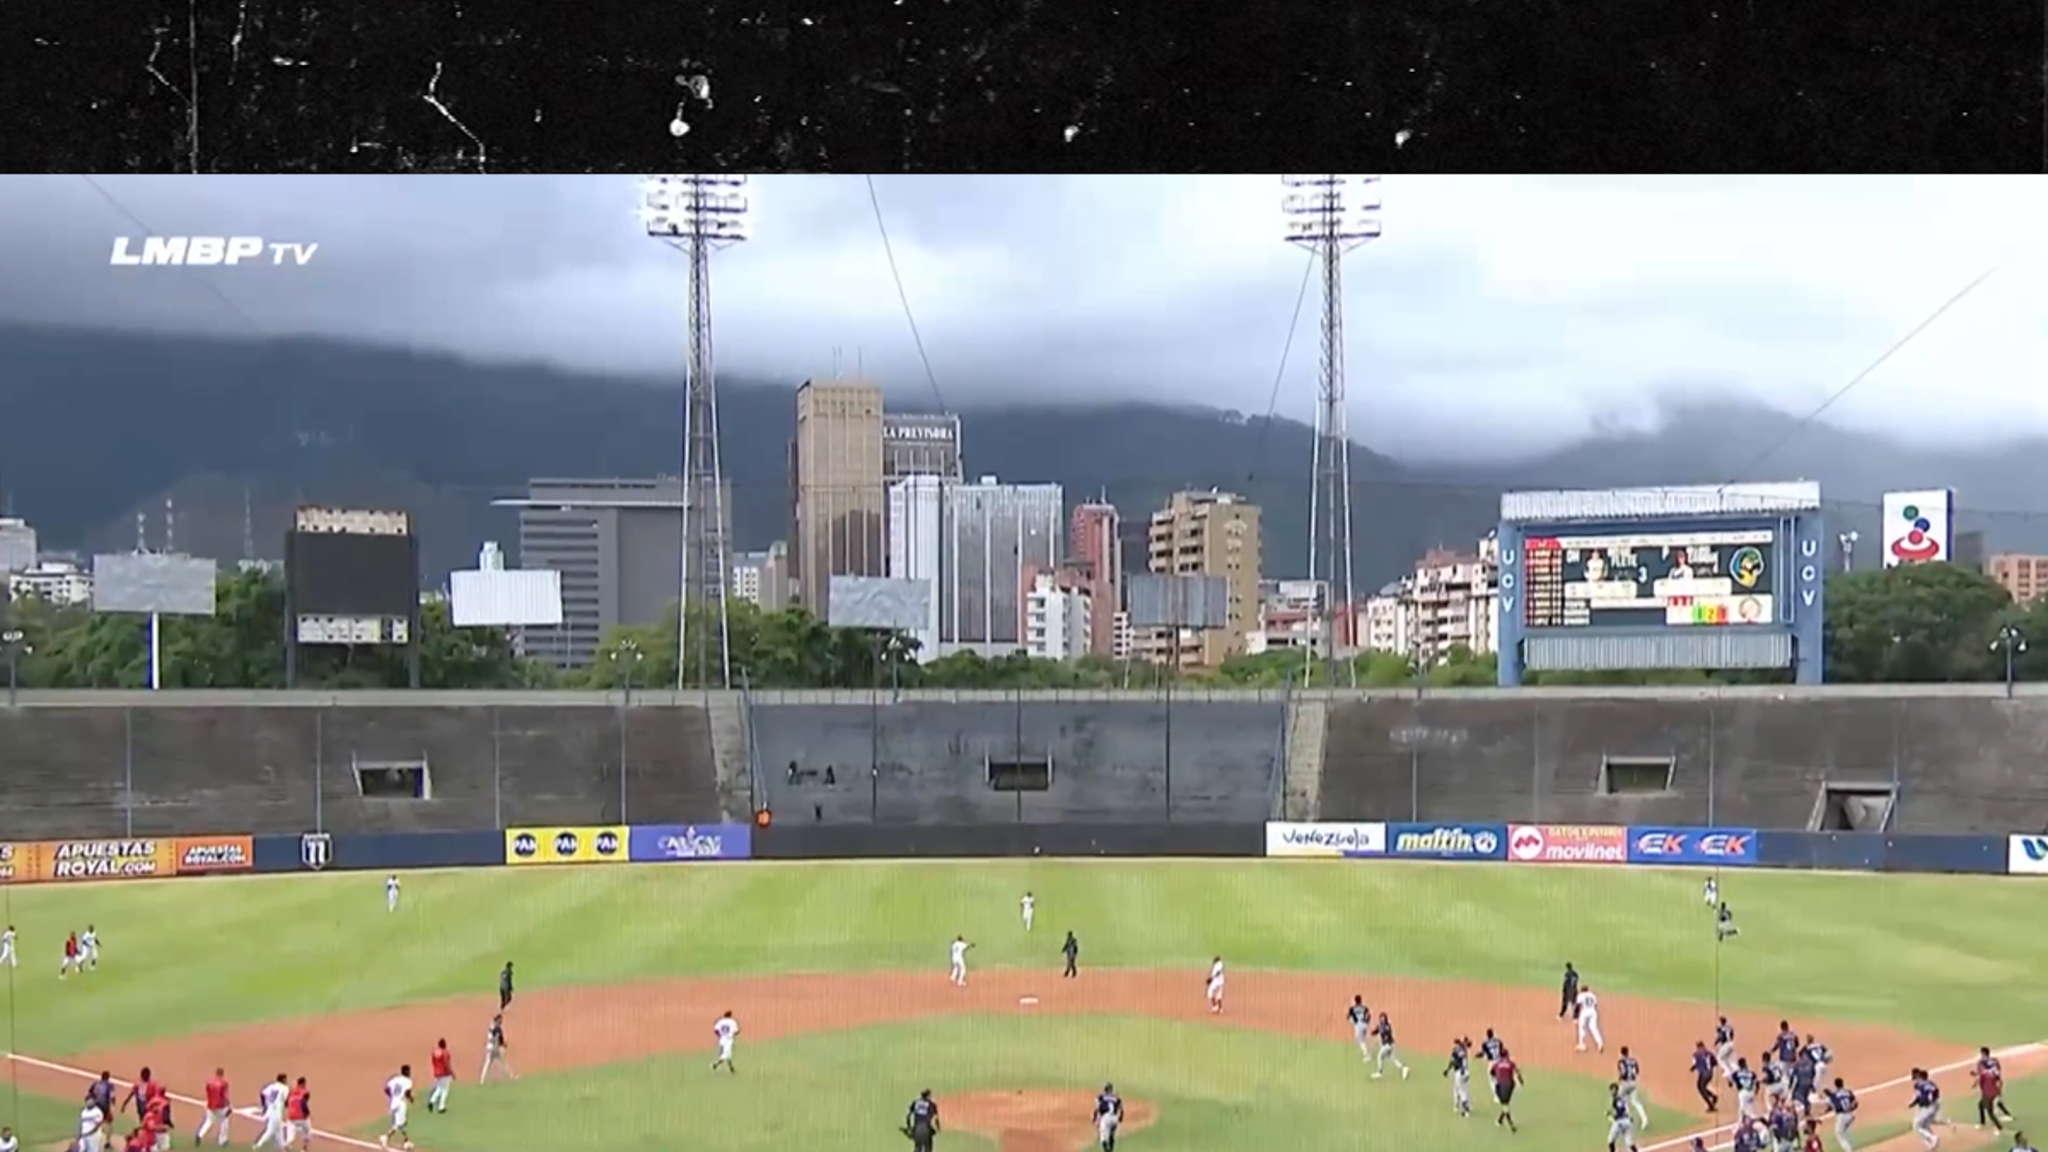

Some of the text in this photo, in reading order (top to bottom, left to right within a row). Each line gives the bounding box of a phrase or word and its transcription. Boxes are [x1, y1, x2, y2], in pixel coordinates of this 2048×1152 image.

[883, 426, 896, 438] LA
[1638, 566, 1648, 583] 3
[1802, 540, 1816, 606] UCV
[55, 841, 155, 859] APUESTAS
[1546, 843, 1624, 860] movilnet
[55, 858, 155, 876] ROYAL.COM
